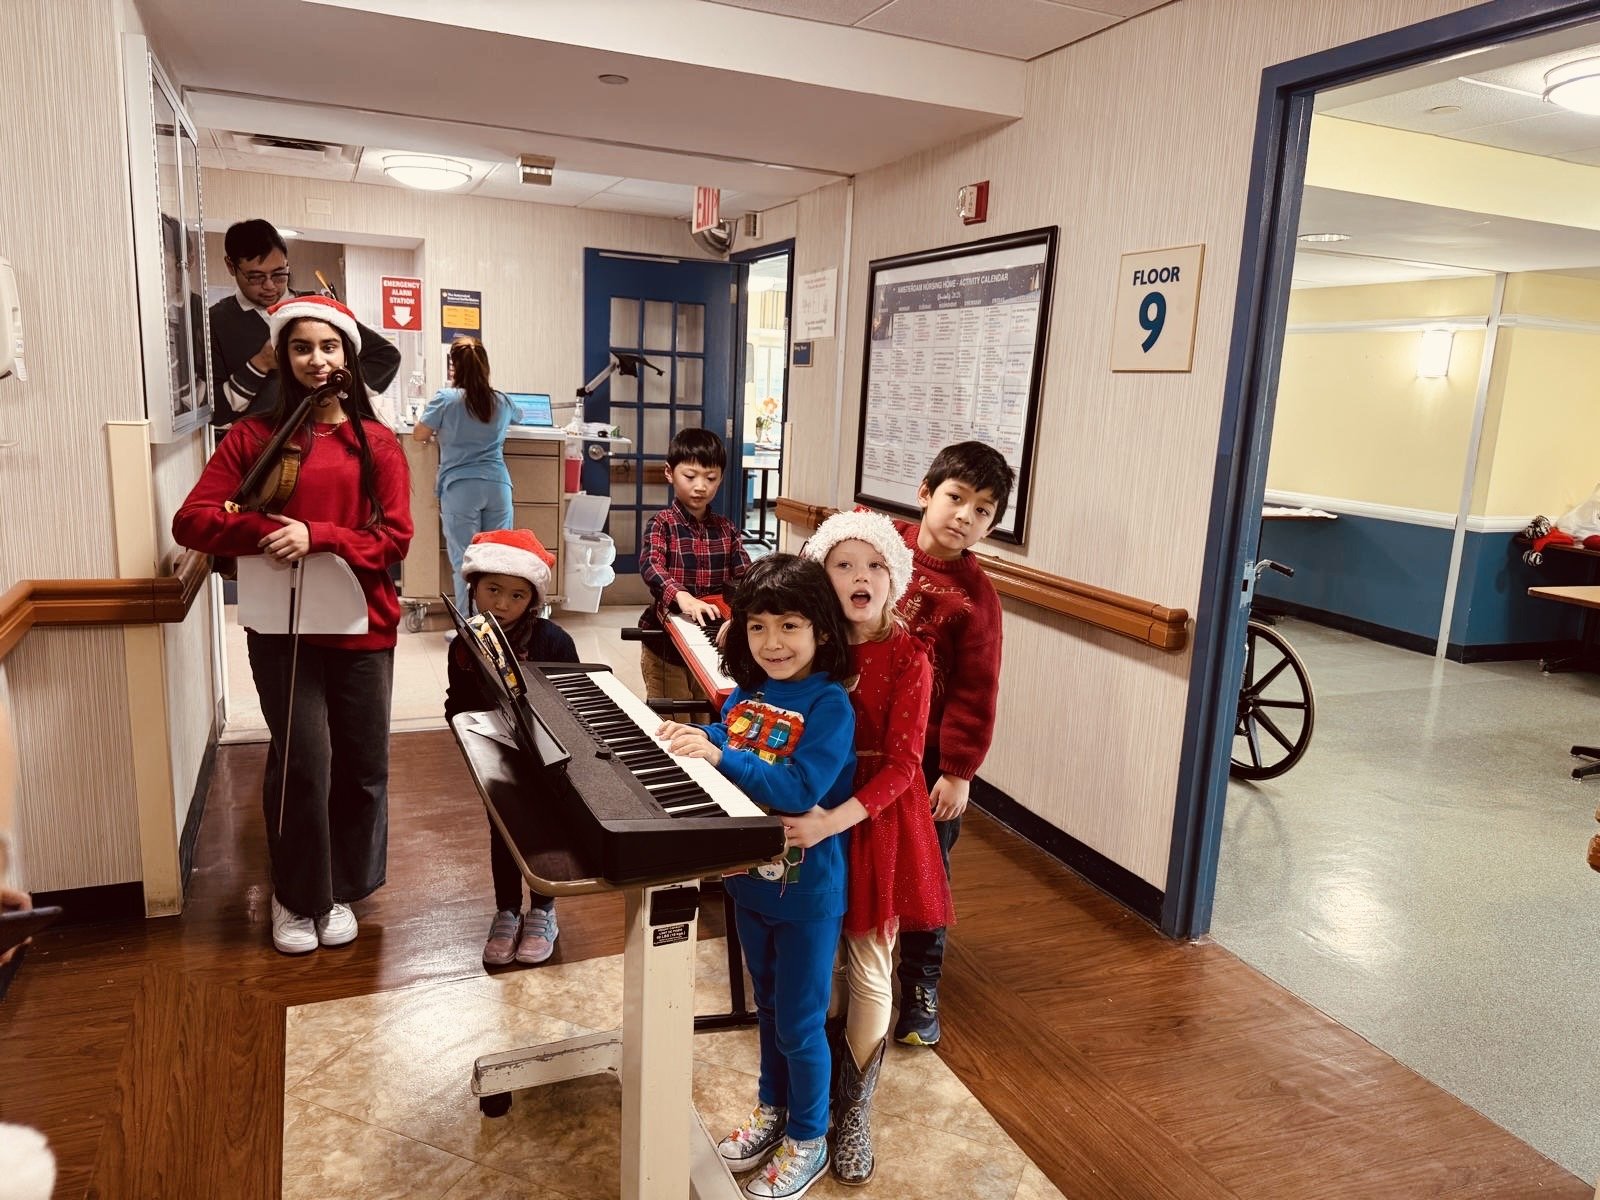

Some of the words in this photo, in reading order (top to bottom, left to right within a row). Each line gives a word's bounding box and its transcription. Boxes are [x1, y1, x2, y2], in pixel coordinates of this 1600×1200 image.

[697, 186, 716, 229] EXIT
[383, 280, 420, 289] EMERGENCY
[897, 283, 923, 293] AMSTERDAM
[923, 281, 942, 291] NURSING
[943, 279, 956, 289] HOME
[960, 276, 981, 286] ACTIVITY
[981, 273, 1009, 284] CALENDAR
[1132, 266, 1181, 286] FLOOR
[389, 297, 415, 305] STATION
[391, 289, 412, 297] ALARM
[1138, 291, 1167, 353] 9
